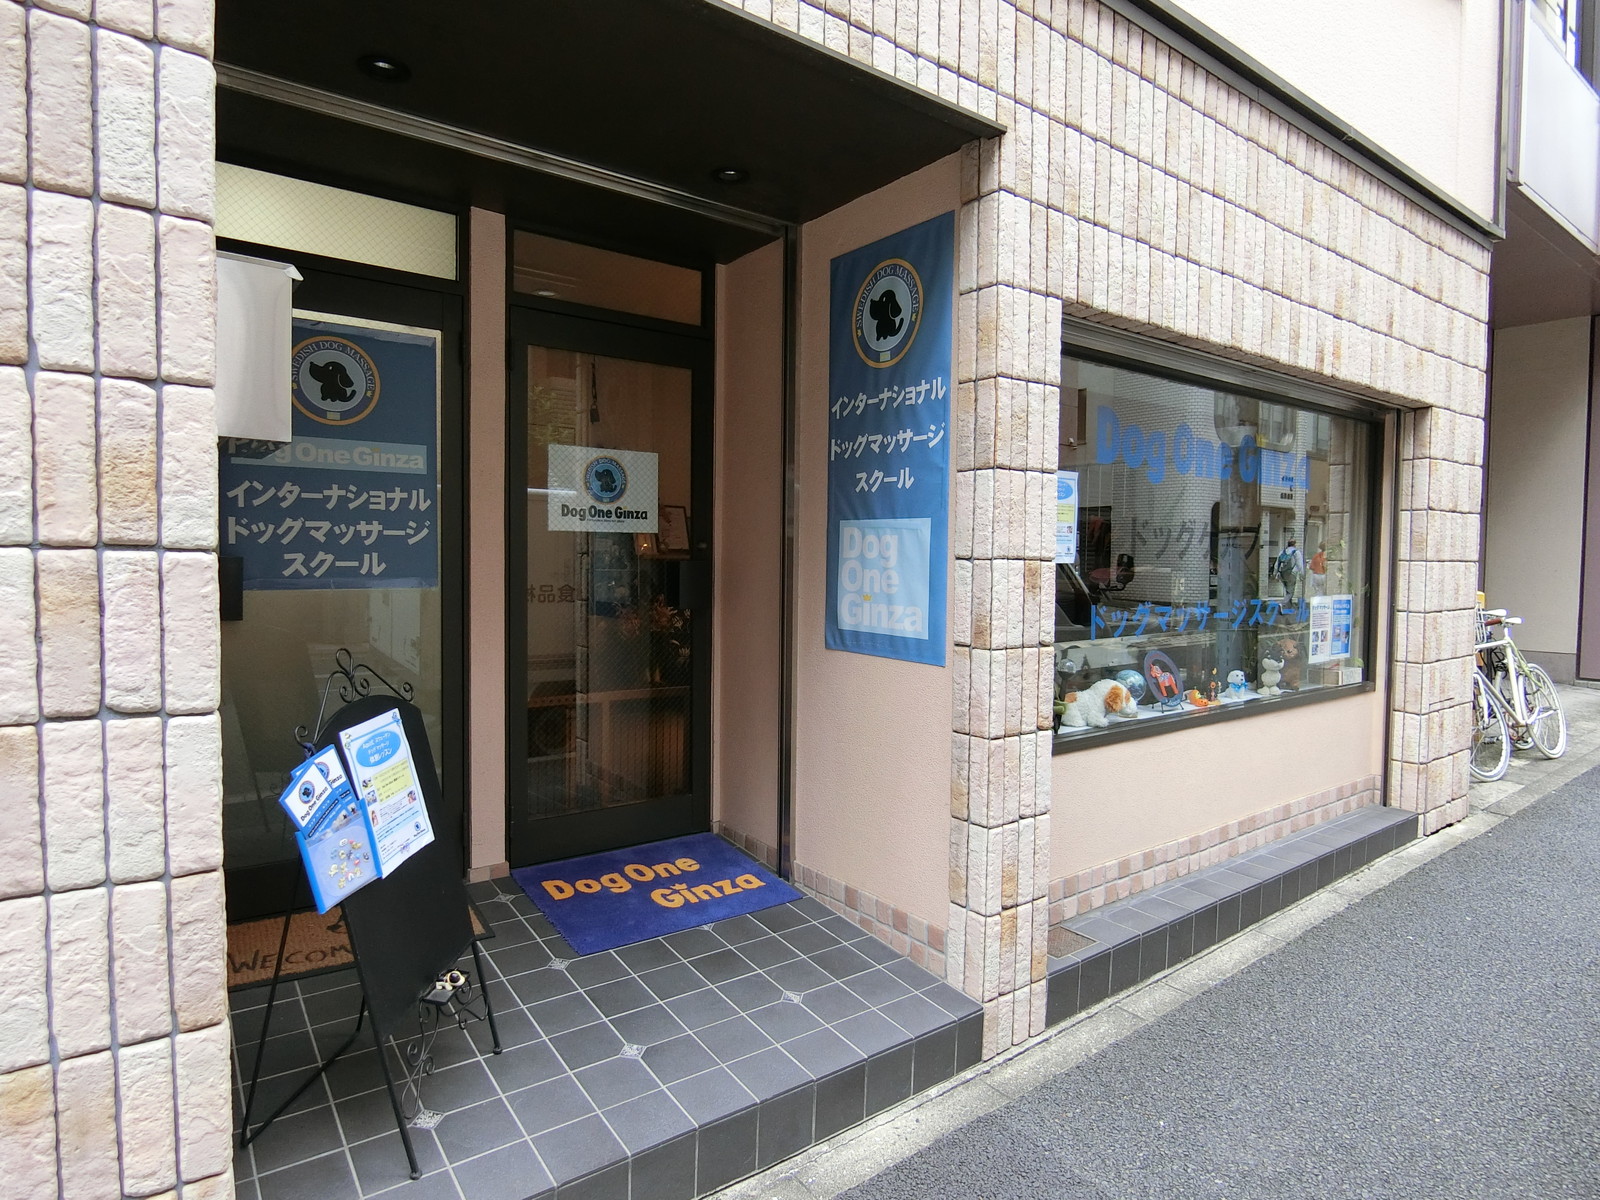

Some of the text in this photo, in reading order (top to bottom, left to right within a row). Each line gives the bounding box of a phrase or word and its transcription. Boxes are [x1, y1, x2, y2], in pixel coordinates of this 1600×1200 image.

[856, 265, 919, 328] SWEDISH DOG MASSAGE
[292, 341, 376, 390] SWEDISH DOG MASSAGE
[831, 376, 947, 420] インターナショナル
[830, 421, 946, 461] ドッグマッサージ
[1096, 406, 1167, 485] Dog
[1173, 422, 1232, 480] One
[1239, 433, 1311, 489] Ginza
[226, 480, 432, 512] インターナショナル
[855, 467, 915, 493] スクール
[561, 503, 648, 521] Dog One Ginza
[228, 516, 431, 545] ドッグマッサージ
[842, 526, 899, 569] Dog
[282, 551, 387, 577] スクール
[841, 559, 899, 594] One
[841, 592, 923, 632] Ginza
[1091, 598, 1309, 641] ドッグマッサージスクール
[300, 810, 311, 822] Dog
[308, 801, 317, 811] One
[651, 873, 767, 908] Ginza
[228, 944, 354, 973] WECOM
